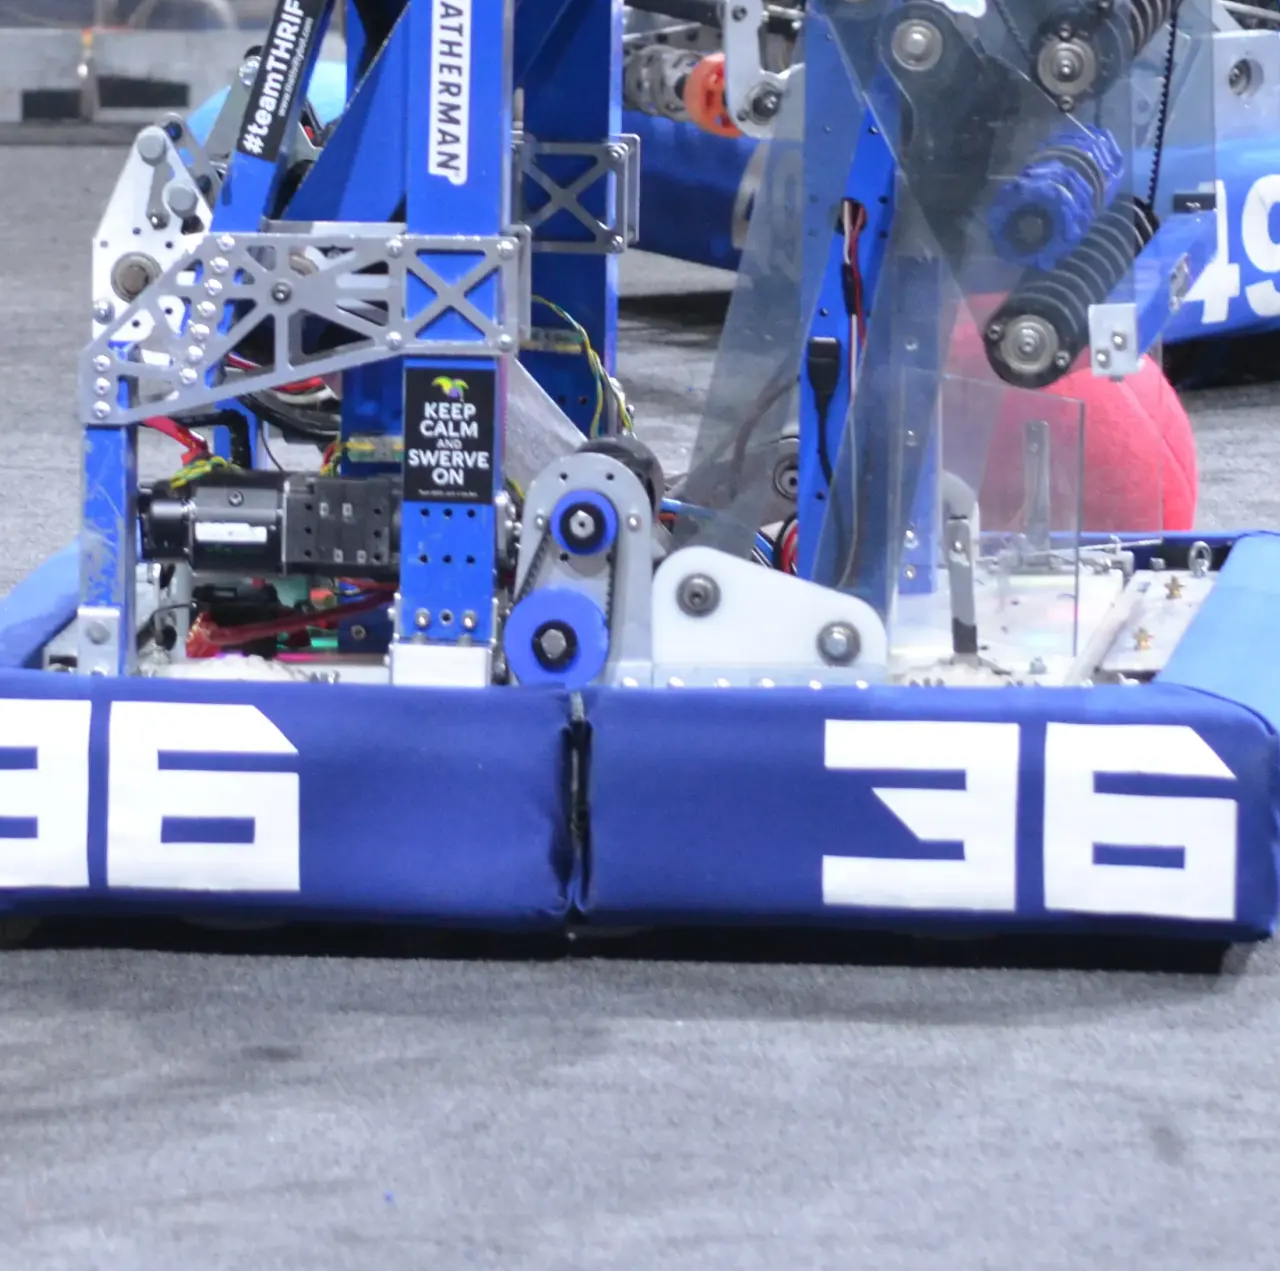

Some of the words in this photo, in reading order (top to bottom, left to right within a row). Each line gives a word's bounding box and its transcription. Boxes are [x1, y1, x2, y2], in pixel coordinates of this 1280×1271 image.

[424, 402, 477, 420] KEEP
[419, 419, 479, 438] CALM
[436, 438, 463, 449] AND
[407, 449, 490, 468] SWERVE
[431, 468, 464, 485] ON
[821, 718, 1238, 920] 36
